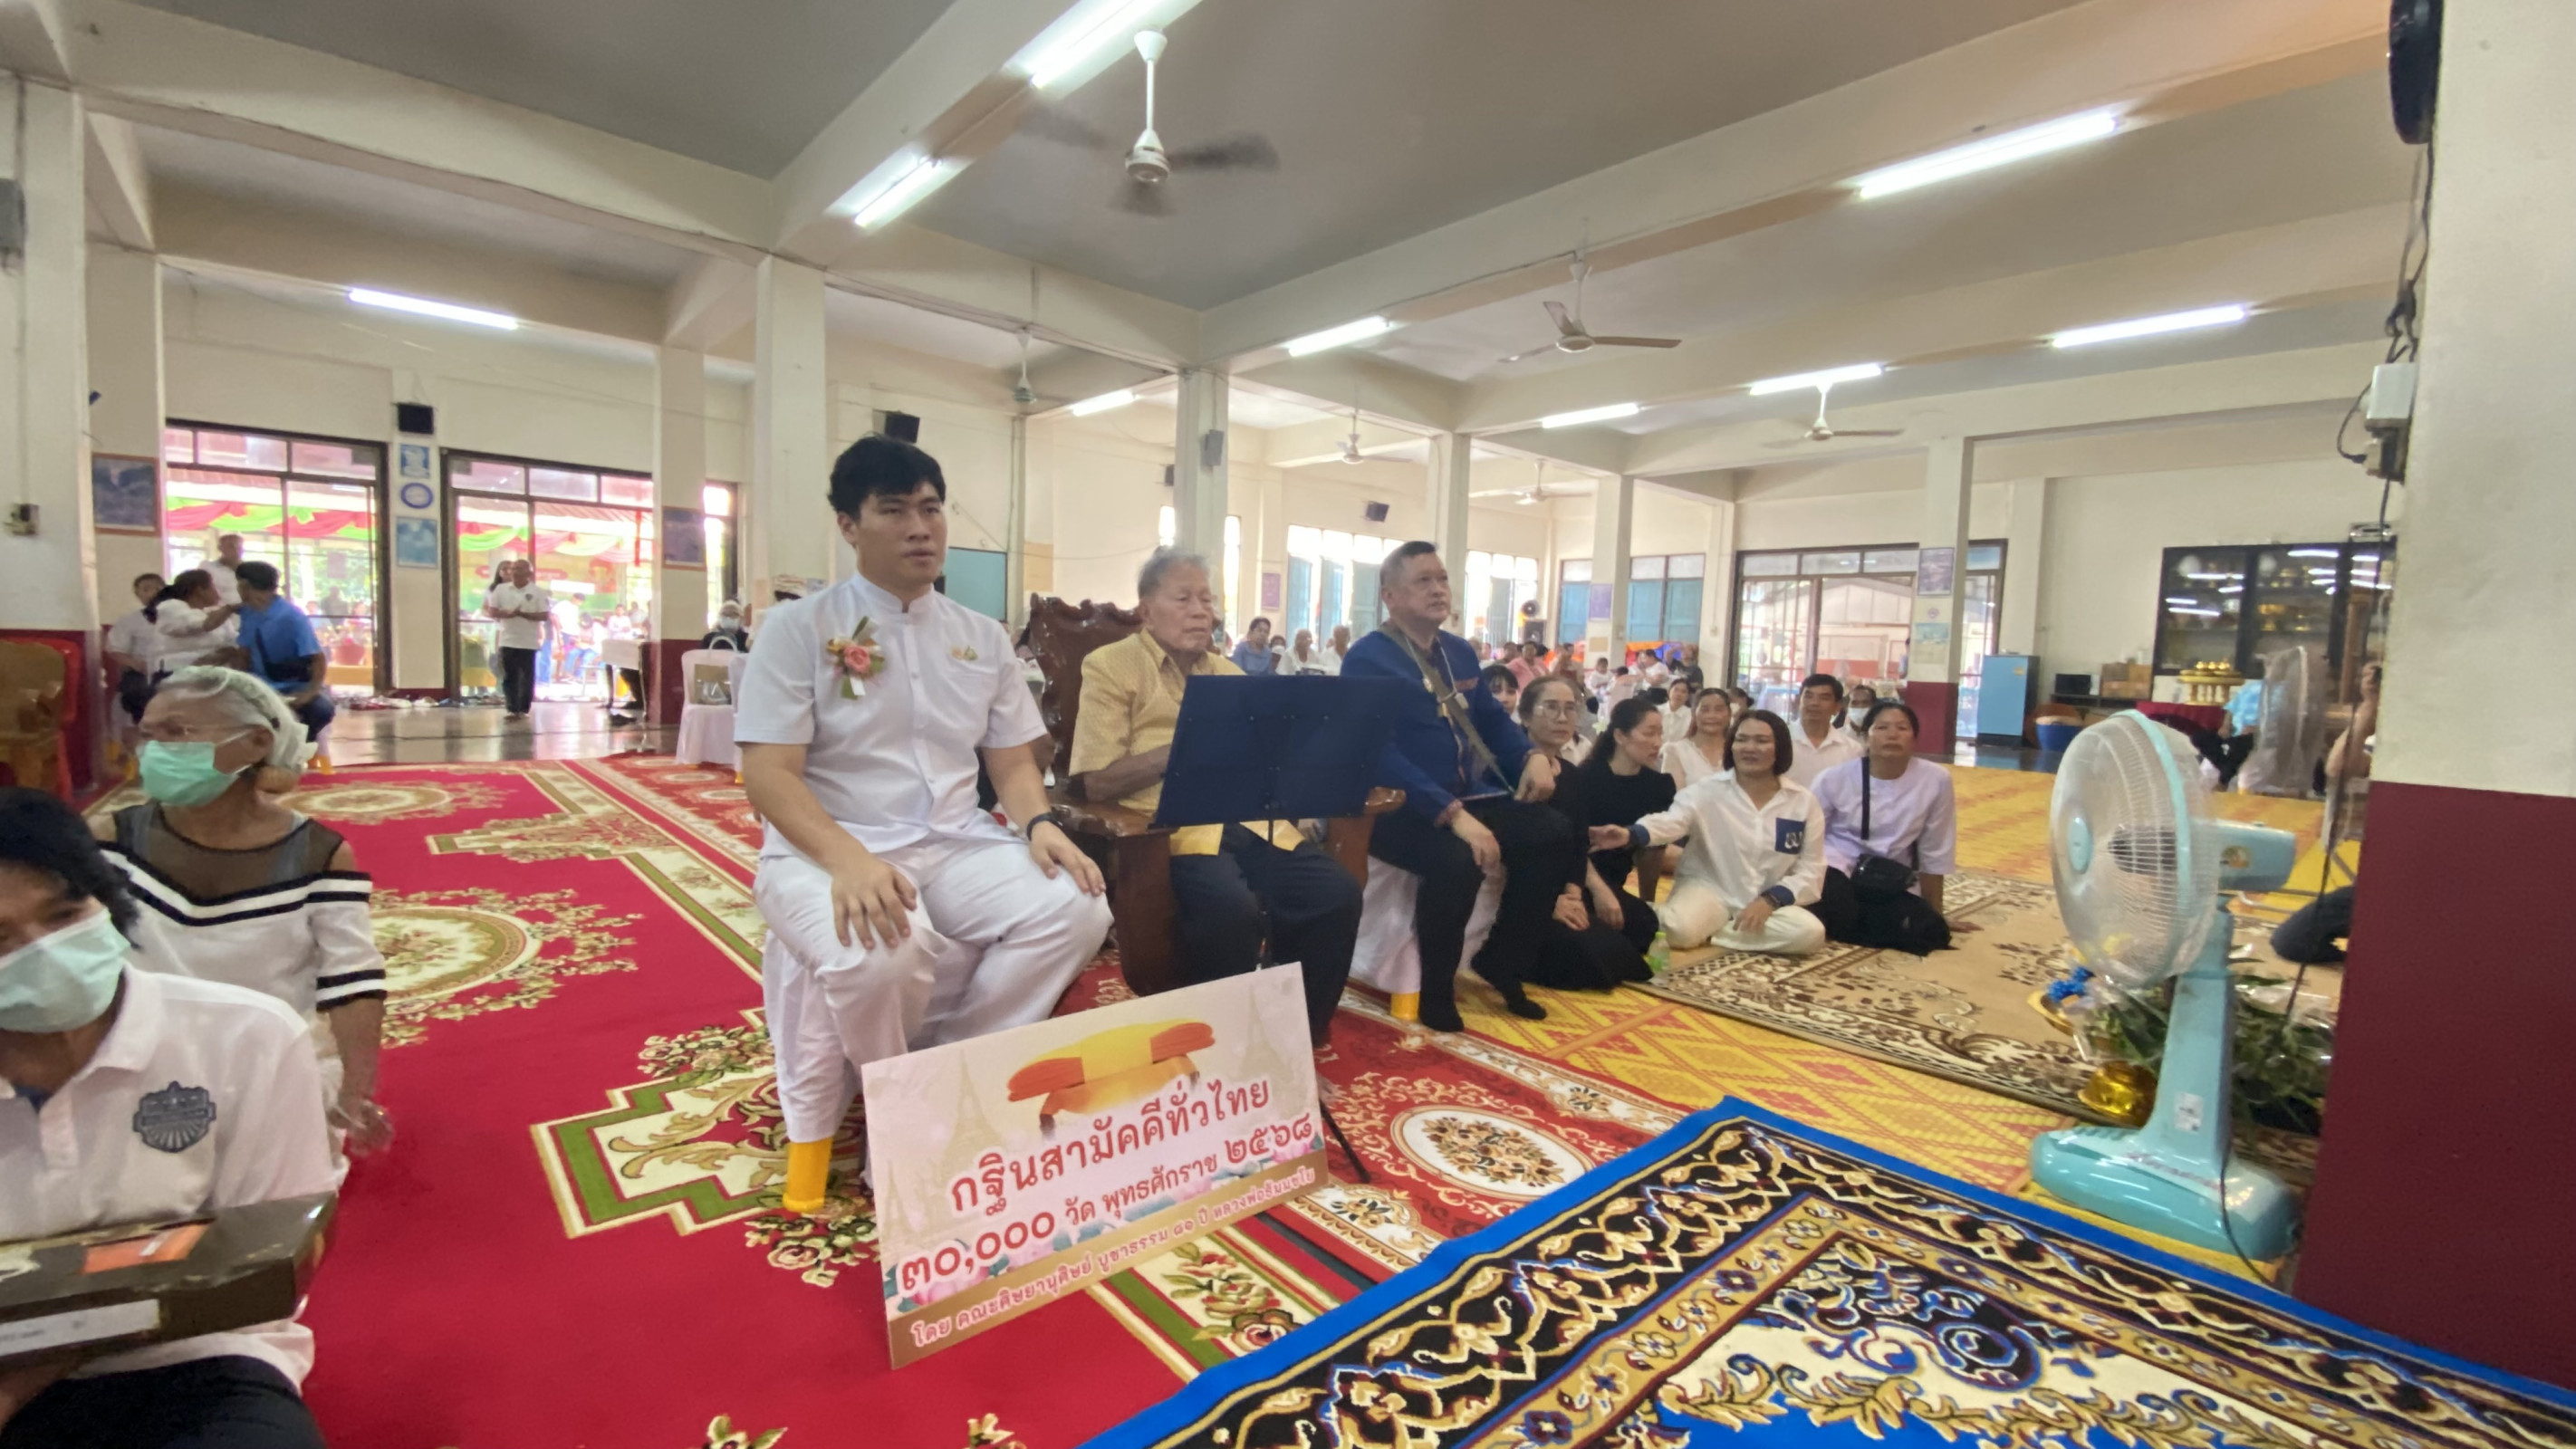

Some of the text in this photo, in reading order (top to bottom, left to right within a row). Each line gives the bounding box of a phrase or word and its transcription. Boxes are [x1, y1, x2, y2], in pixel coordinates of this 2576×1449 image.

[902, 1113, 1313, 1291] ๓๐,๐๐๐ วัด พุทธศักราช ๒๕๖๘
[952, 1078, 1269, 1216] กฐินสามัคคีทั่วไทย
[911, 1318, 951, 1346] โดย
